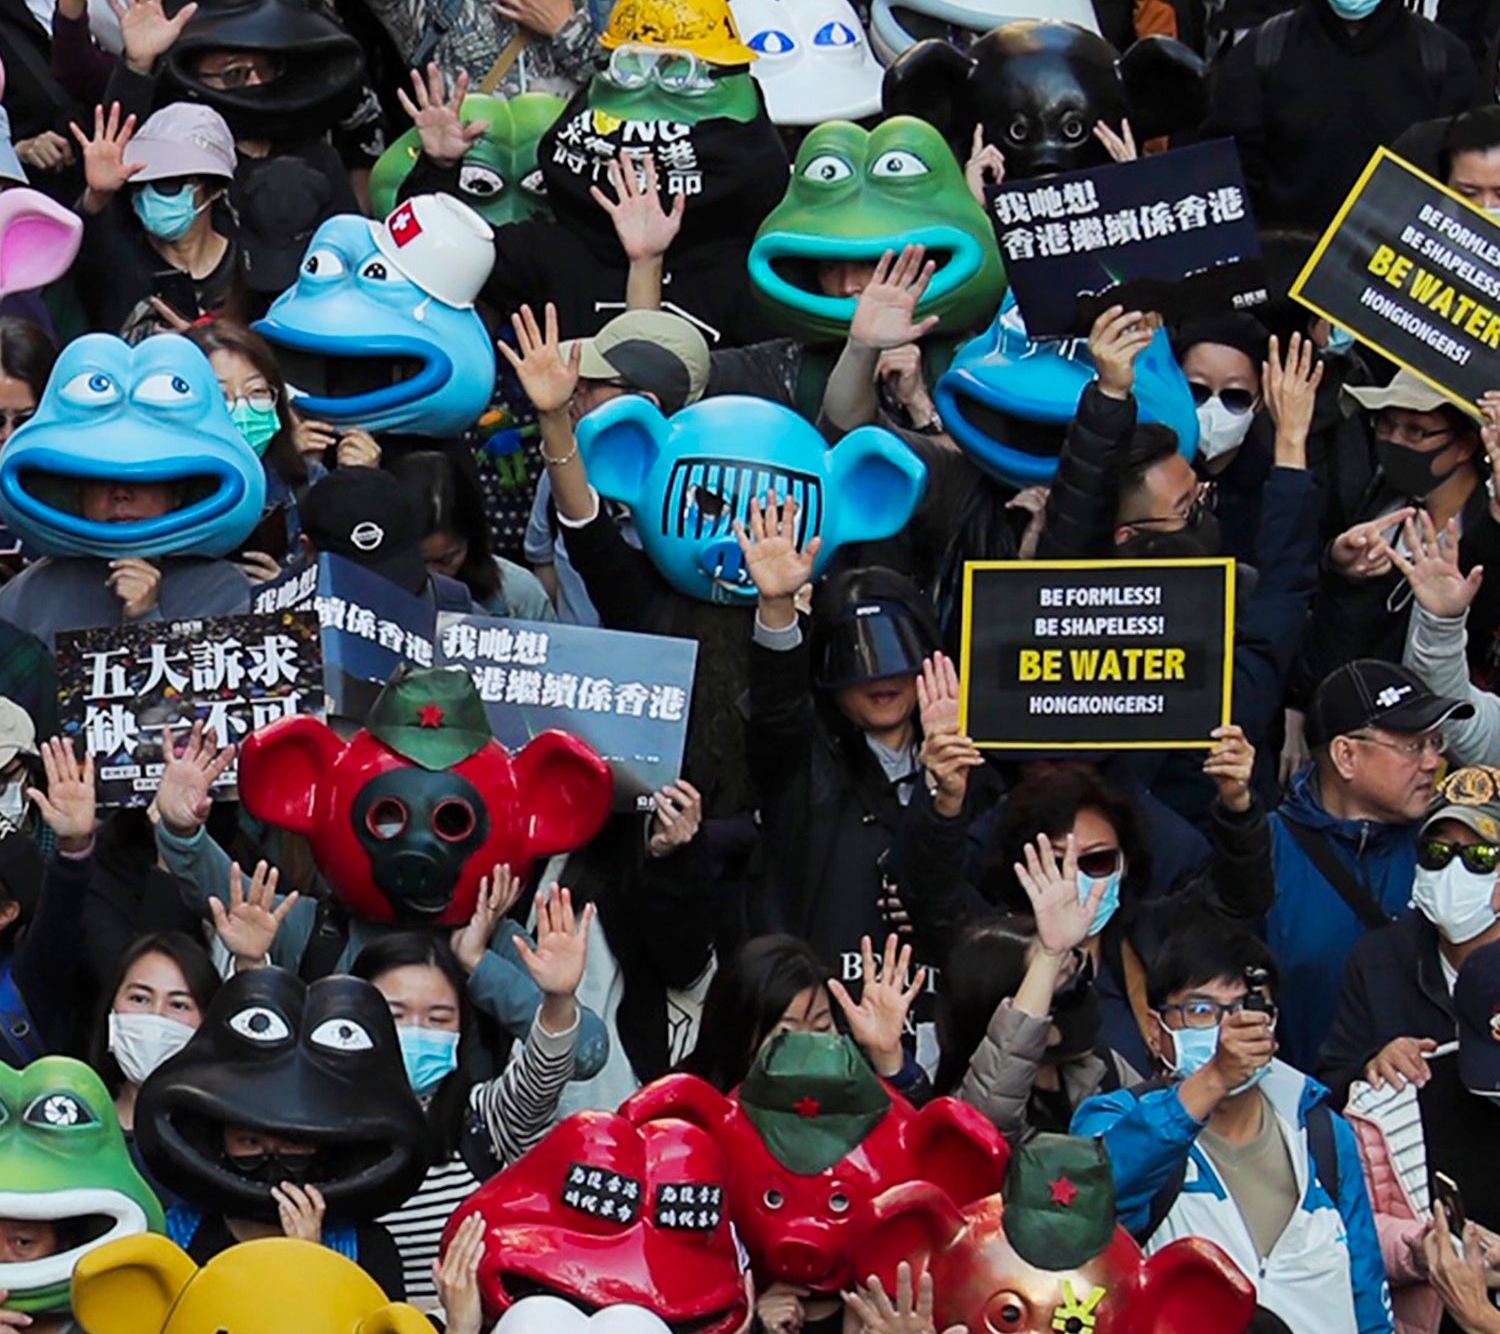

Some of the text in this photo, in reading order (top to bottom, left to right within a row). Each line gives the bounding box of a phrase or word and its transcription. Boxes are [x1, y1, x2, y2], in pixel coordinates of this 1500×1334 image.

[994, 179, 1099, 225] 我哋想
[1002, 185, 1244, 261] 香港繼續係香港
[1418, 203, 1441, 228] BE
[1400, 225, 1423, 249] BE
[1366, 243, 1415, 289] BE
[1360, 288, 1473, 366] HONGKONGERS!
[1039, 586, 1163, 607] BE FORMLESS!
[441, 623, 550, 665] 我哋想
[1034, 616, 1165, 637] BE SHAPELESS!
[82, 633, 301, 704] 五大訴求
[1017, 647, 1188, 682] BE WATER
[444, 664, 687, 721] 港繼續係香港
[1028, 695, 1165, 715] HONGKONGERS!
